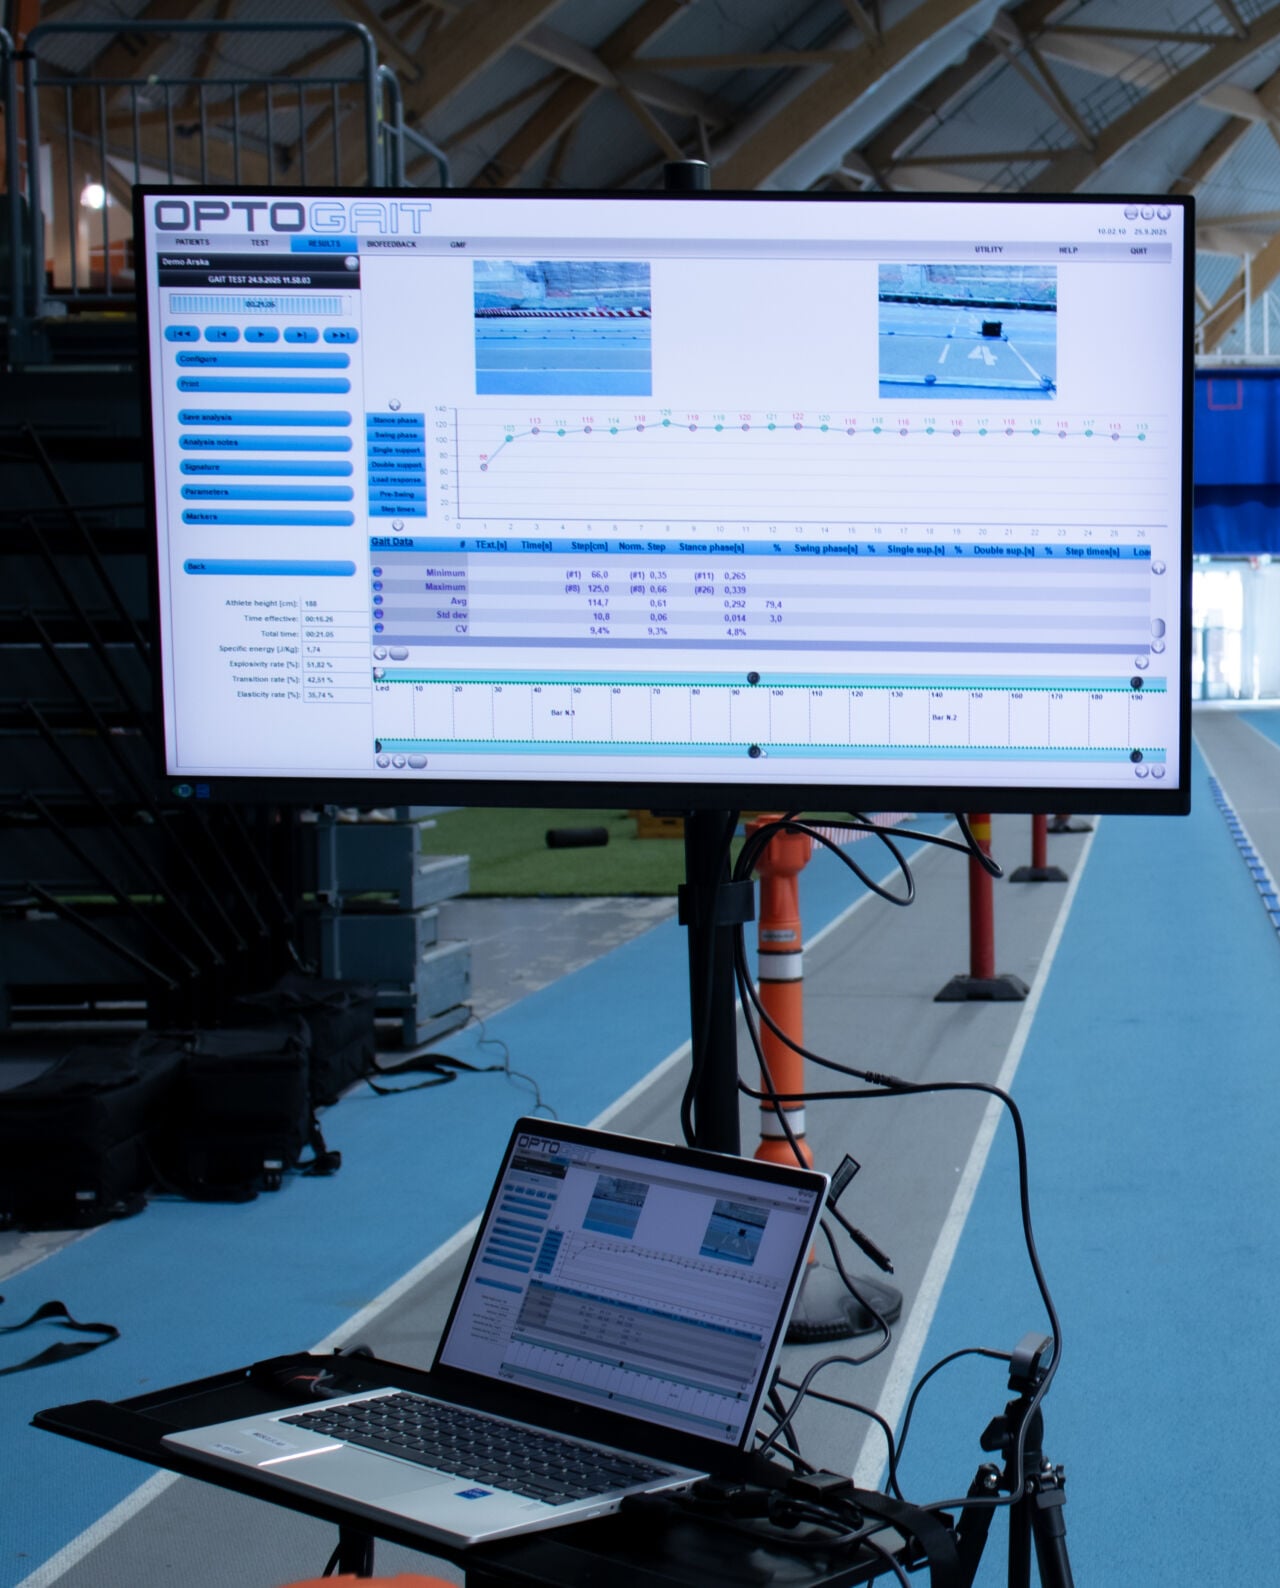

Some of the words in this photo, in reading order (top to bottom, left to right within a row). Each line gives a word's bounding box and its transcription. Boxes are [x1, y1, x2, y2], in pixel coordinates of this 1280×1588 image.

[154, 200, 432, 234] OPTOGAIT
[175, 238, 210, 246] PATIENTS
[367, 240, 417, 248] BIOFEEDBACK
[1130, 247, 1148, 255] QUIT
[162, 258, 185, 266] Demo
[207, 275, 226, 283] GAIT
[228, 275, 246, 284] TEST
[180, 355, 217, 364] Configure
[182, 413, 200, 421] Save
[202, 413, 232, 422] analysis
[183, 438, 215, 447] Analysis
[373, 446, 393, 454] Single
[394, 447, 420, 455] support
[184, 463, 220, 472] Signature
[185, 488, 229, 496] Parameters
[379, 491, 415, 499] Pre-Swing
[381, 505, 396, 513] Step
[371, 537, 390, 546] Gait
[393, 538, 414, 547] Data
[475, 541, 508, 551] TExt.[s]
[521, 541, 552, 551] Time[s]
[571, 541, 609, 551] Step[cm]
[619, 542, 644, 551] Norm.
[647, 543, 666, 552] Step
[679, 543, 707, 551] Stance
[710, 543, 745, 553] phase[s]
[794, 544, 820, 554] Swing
[823, 544, 858, 554] phase[s]
[887, 544, 914, 555] Single
[916, 545, 945, 555] sup.[s]
[974, 545, 1004, 554] Double
[1006, 546, 1035, 556] sup.[s]
[1065, 547, 1084, 556] Step
[1087, 547, 1120, 556] times[s]
[426, 568, 466, 577] Minimum
[566, 570, 581, 580] (#1)
[591, 571, 608, 579] 66,0
[630, 571, 645, 580] (#1)
[650, 571, 667, 580] 0,35
[694, 572, 714, 581] (#11)
[724, 572, 746, 580] 0,265
[425, 583, 466, 591] Maximum
[565, 585, 580, 594] (#8)
[588, 585, 609, 593] 125,0
[630, 586, 645, 594] (#8)
[650, 586, 667, 594] 0,66
[694, 586, 714, 595] (#26)
[724, 586, 746, 595] 0,339
[254, 600, 277, 608] height
[279, 600, 298, 608] [cm]:
[450, 597, 467, 607] Avg
[588, 599, 609, 607] 114,7
[650, 600, 667, 608] 0,61
[724, 600, 746, 608] 0,292
[765, 601, 782, 609] 79,4
[436, 611, 450, 619] Std
[453, 611, 468, 619] dev
[593, 612, 610, 621] 10,8
[650, 613, 667, 622] 0,06
[724, 614, 746, 622] 0,014
[770, 615, 782, 623] 3,0
[455, 625, 468, 633] CV
[590, 626, 609, 635] 9,4%
[648, 627, 667, 636] 9,3%
[726, 628, 746, 636] 4,8%
[219, 645, 247, 653] Specific
[249, 646, 275, 654] energy
[229, 660, 268, 668] Explosivity
[286, 661, 300, 669] [%]:
[287, 676, 300, 684] [%]:
[237, 690, 269, 699] Elasticity
[287, 691, 301, 699] [%]:
[375, 684, 390, 692] Led
[612, 687, 621, 695] 60
[692, 688, 700, 696] 80
[772, 689, 784, 697] 100
[1091, 693, 1103, 701] 180
